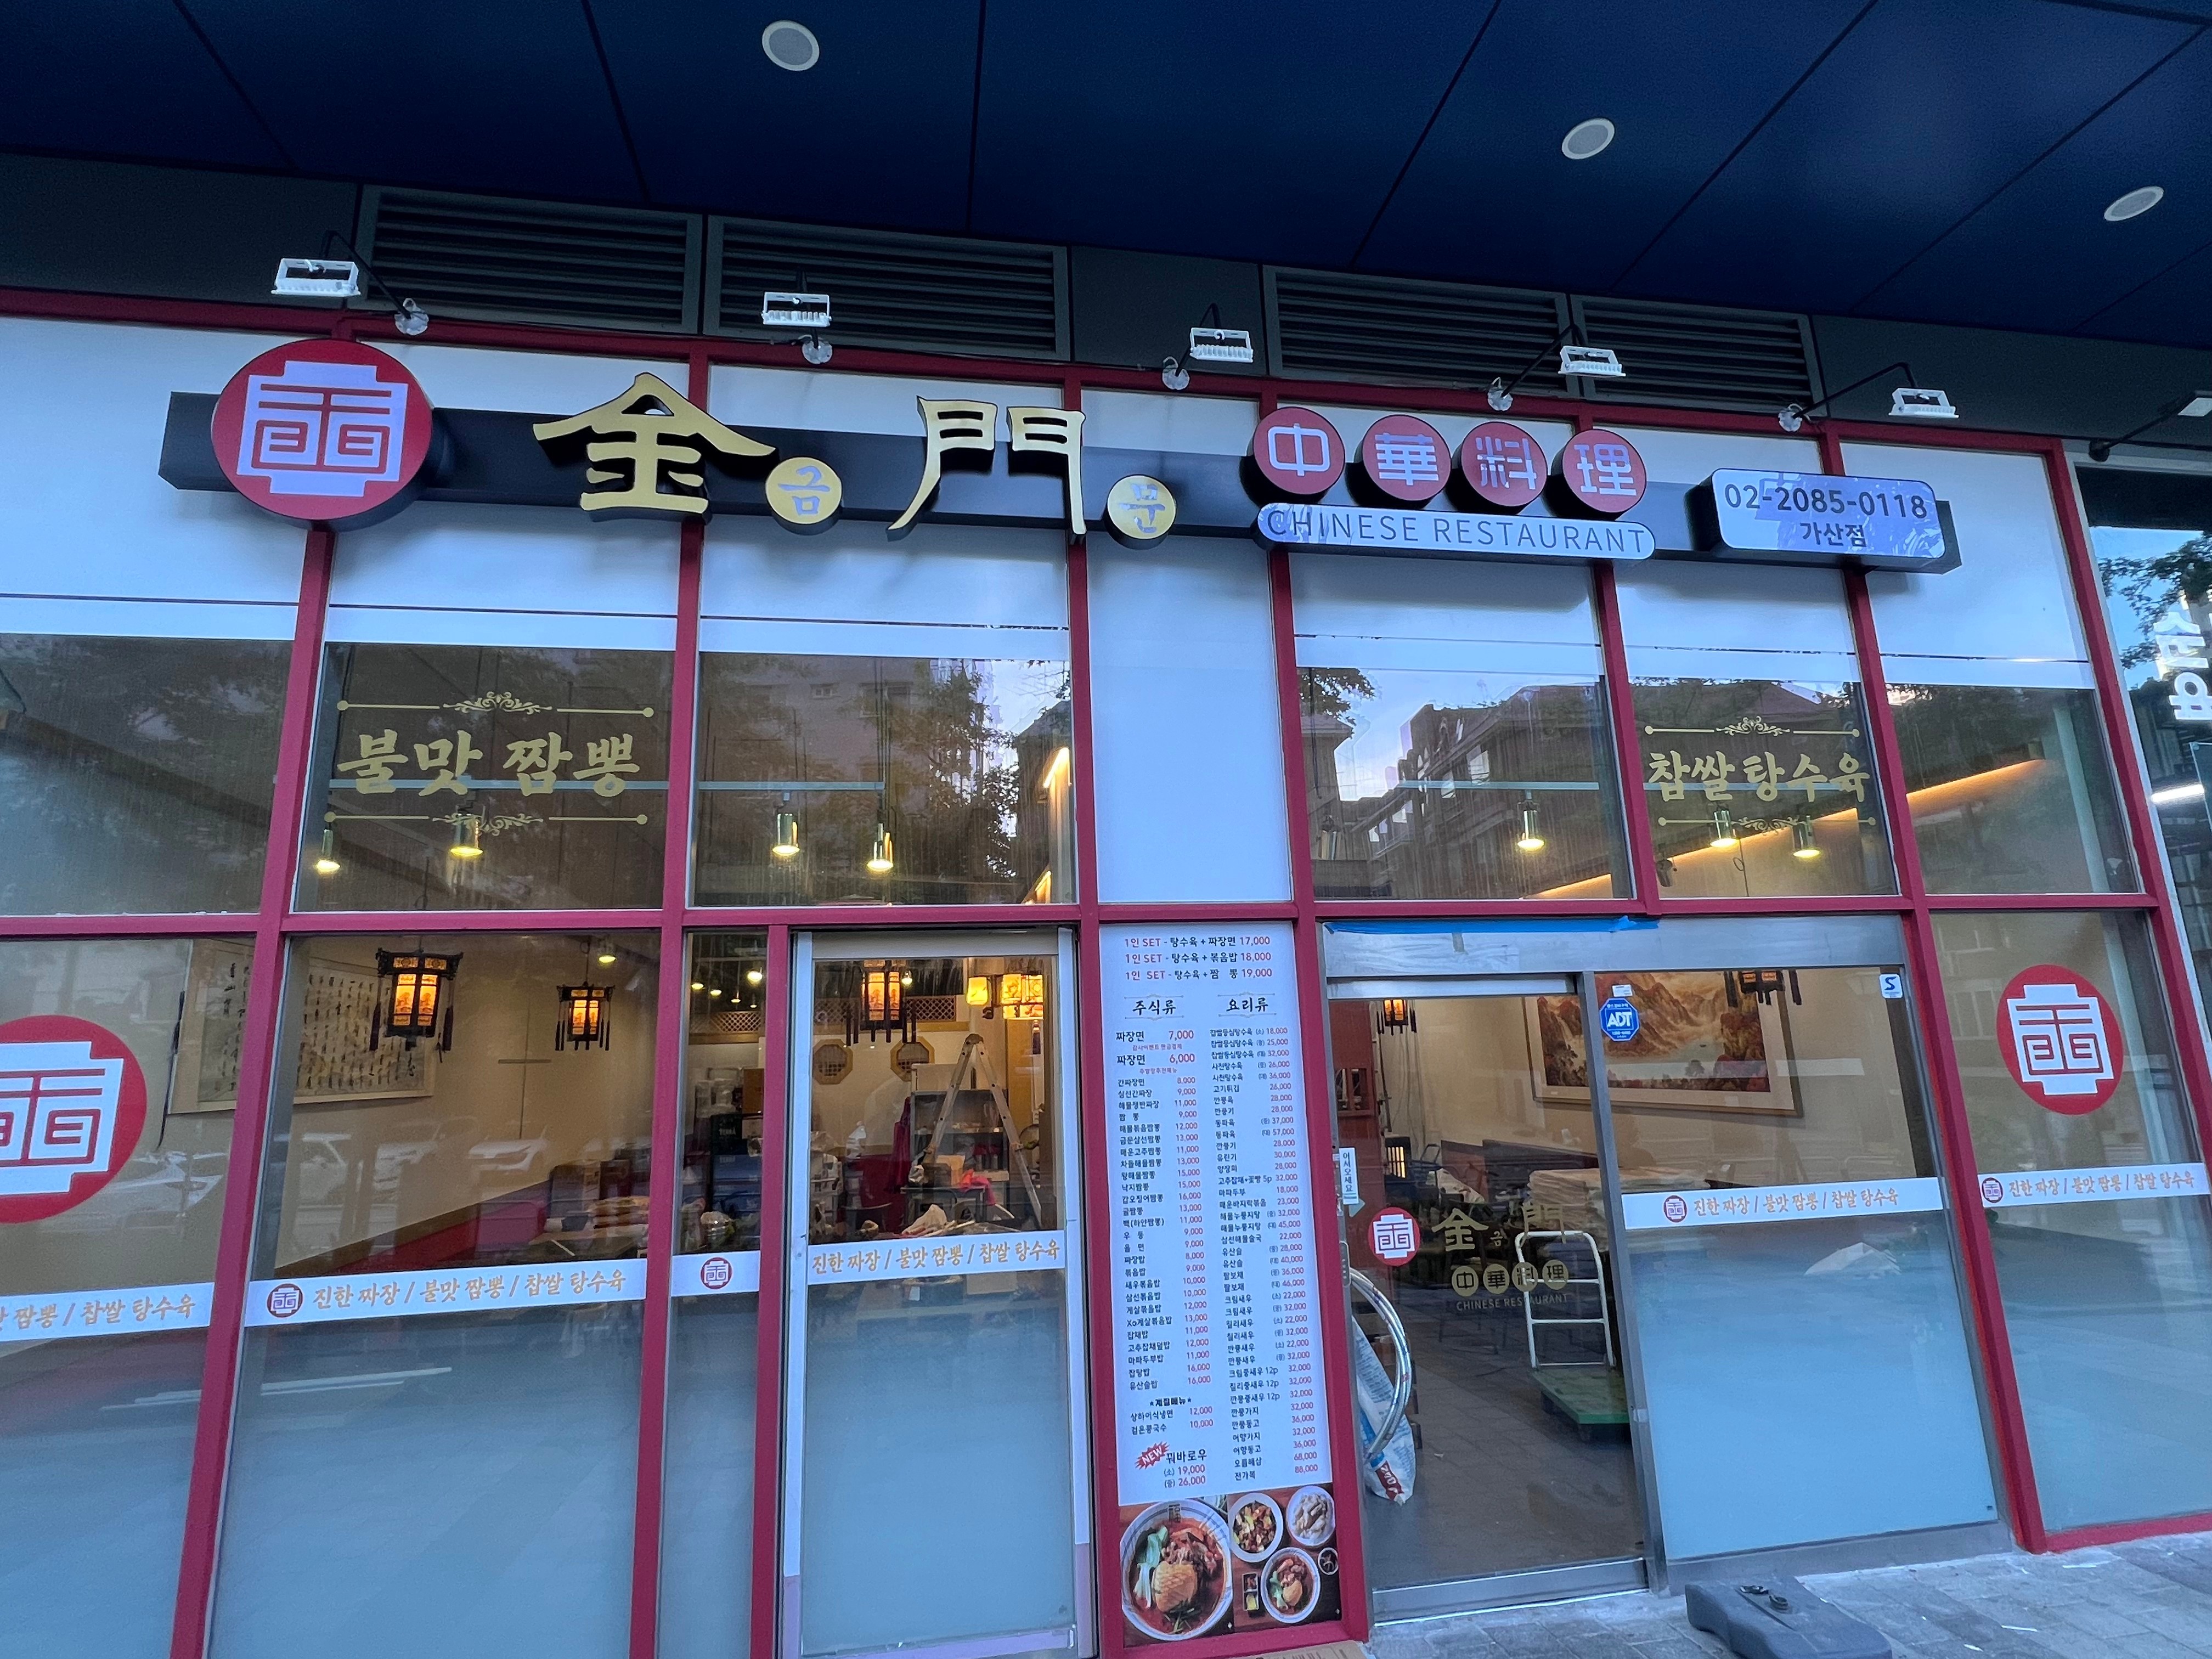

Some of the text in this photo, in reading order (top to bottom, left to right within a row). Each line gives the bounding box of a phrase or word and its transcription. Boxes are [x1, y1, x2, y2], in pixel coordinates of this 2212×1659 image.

[533, 372, 1165, 535] 金 금 門 문
[1267, 422, 1637, 496] 中華料理
[1724, 483, 1927, 518] 02-2085-0118
[1268, 509, 1645, 554] CHINESE RESTAURANT
[1799, 522, 1866, 548] 가산점
[337, 729, 640, 797] 불맛 짬뽕
[1124, 935, 1271, 949] 1인 SET 탕수육 짜장면 17,000
[1124, 951, 1272, 964] 1인 SET 탕수육 볶음밥 18,000
[1124, 970, 1141, 981] 1인
[1145, 970, 1166, 980] SET
[1173, 969, 1200, 981] 탕수육
[1240, 968, 1273, 979] 19,000
[1131, 996, 1269, 1016] 주식류 요리류
[1607, 1012, 1632, 1027] ADT
[1114, 1029, 1194, 1043] 짜장면 7,000
[1266, 1027, 1289, 1035] 18,000
[1115, 1053, 1195, 1066] 짜장면 6,000
[1268, 1060, 1290, 1069] 26,000
[1174, 1099, 1197, 1108] 11,000
[1178, 1110, 1197, 1119] 9,000
[1272, 1116, 1294, 1125] 37,000
[1175, 1122, 1198, 1130] 12,000
[1272, 1128, 1294, 1136] 57,000
[1176, 1133, 1198, 1142] 13,000
[1176, 1146, 1199, 1154] 11,000
[1177, 1157, 1199, 1165] 13,000
[1177, 1169, 1200, 1177] 15,000
[1178, 1180, 1200, 1189] 15,000
[2009, 1179, 2032, 1197] 진한
[1178, 1192, 1201, 1200] 16,000
[1694, 1187, 1898, 1216] 진한 짜장 불맛 짬뽕 찹쌀 탕수육
[1179, 1204, 1201, 1212] 13,000
[1180, 1215, 1202, 1224] 11,000
[1184, 1227, 1203, 1237] 9,000
[1431, 1208, 1489, 1252] 金
[1184, 1240, 1204, 1249] 9,000
[812, 1239, 1060, 1274] 진한 짜장 불맛 짬뽕 찹쌀 탕수육
[1185, 1264, 1205, 1273] 9,000
[313, 1268, 625, 1309] 진한 짜장 불맛 짬뽕 찹쌀 탕수육
[1183, 1289, 1206, 1297] 10,000
[1283, 1290, 1306, 1299] 22,000
[1183, 1301, 1207, 1311] 12,000
[1456, 1299, 1500, 1311] CHINESE
[15, 1304, 58, 1329] 짬뽕
[82, 1299, 126, 1325] 찹쌀
[133, 1294, 195, 1321] 탕수육
[1184, 1313, 1207, 1323] 13,000
[1285, 1315, 1307, 1323] 22,000
[1185, 1326, 1208, 1335] 11,000
[1186, 1339, 1209, 1347] 12,000
[1286, 1339, 1309, 1348] 22,000
[1186, 1350, 1210, 1359] 11,000
[1286, 1351, 1310, 1360] 32,000
[1187, 1363, 1210, 1372] 16,000
[1265, 1363, 1311, 1376] 12p 32,000
[1187, 1375, 1211, 1385] 16,000
[1266, 1376, 1312, 1389] 12p 32,000
[1267, 1389, 1313, 1401] 12p 32,000
[1189, 1406, 1212, 1415] 12,000
[1290, 1402, 1313, 1411] 32,000
[1189, 1419, 1213, 1429] 10,000
[1291, 1414, 1314, 1424] 36,000
[1292, 1427, 1315, 1436] 32,000
[1293, 1439, 1317, 1449] 36,000
[1142, 1446, 1163, 1464] NEW
[1164, 1448, 1207, 1465] 꿔바로우
[1294, 1451, 1317, 1461] 68,000
[1177, 1463, 1205, 1476] 19,000
[1177, 1474, 1205, 1487] 26,000
